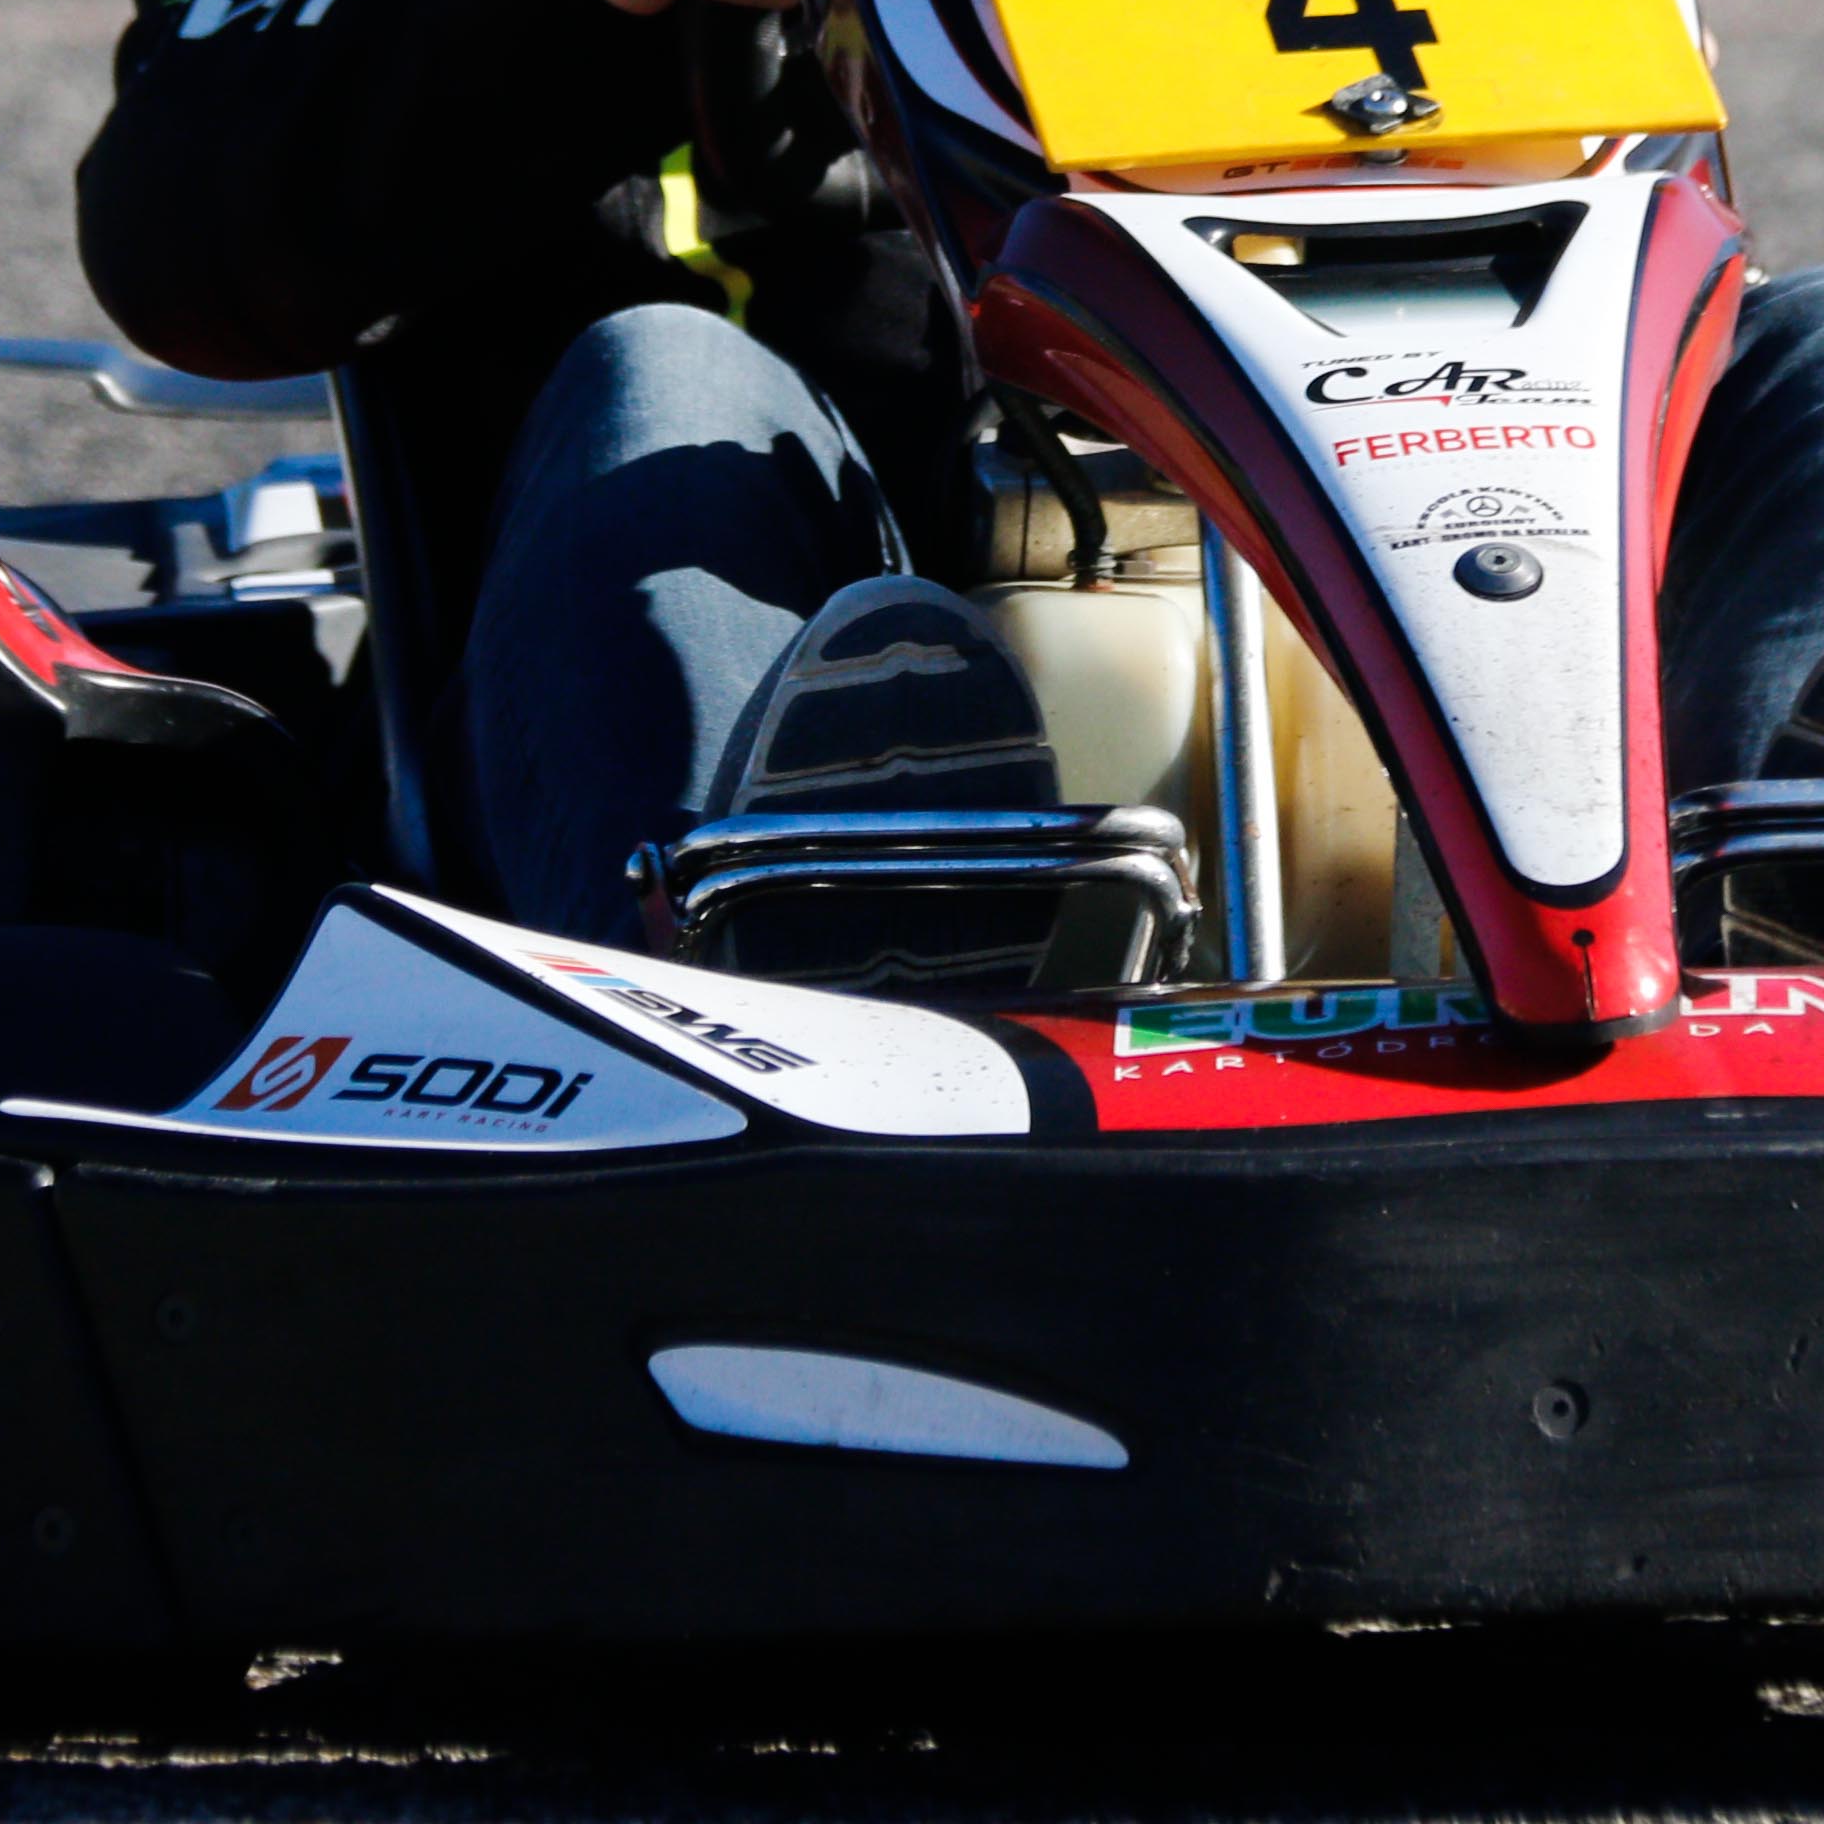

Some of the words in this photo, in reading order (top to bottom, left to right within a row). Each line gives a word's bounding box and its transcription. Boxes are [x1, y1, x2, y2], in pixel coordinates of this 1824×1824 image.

[1302, 352, 1393, 369] TUNED
[1400, 350, 1443, 359] BY
[1332, 424, 1598, 468] FERBERTO
[1416, 486, 1472, 530] ESCOLA
[1478, 485, 1566, 521] KARTING
[604, 988, 819, 1074] SWS
[1689, 1021, 1775, 1037] DA
[383, 1108, 446, 1120] KART
[457, 1114, 550, 1133] RACING
